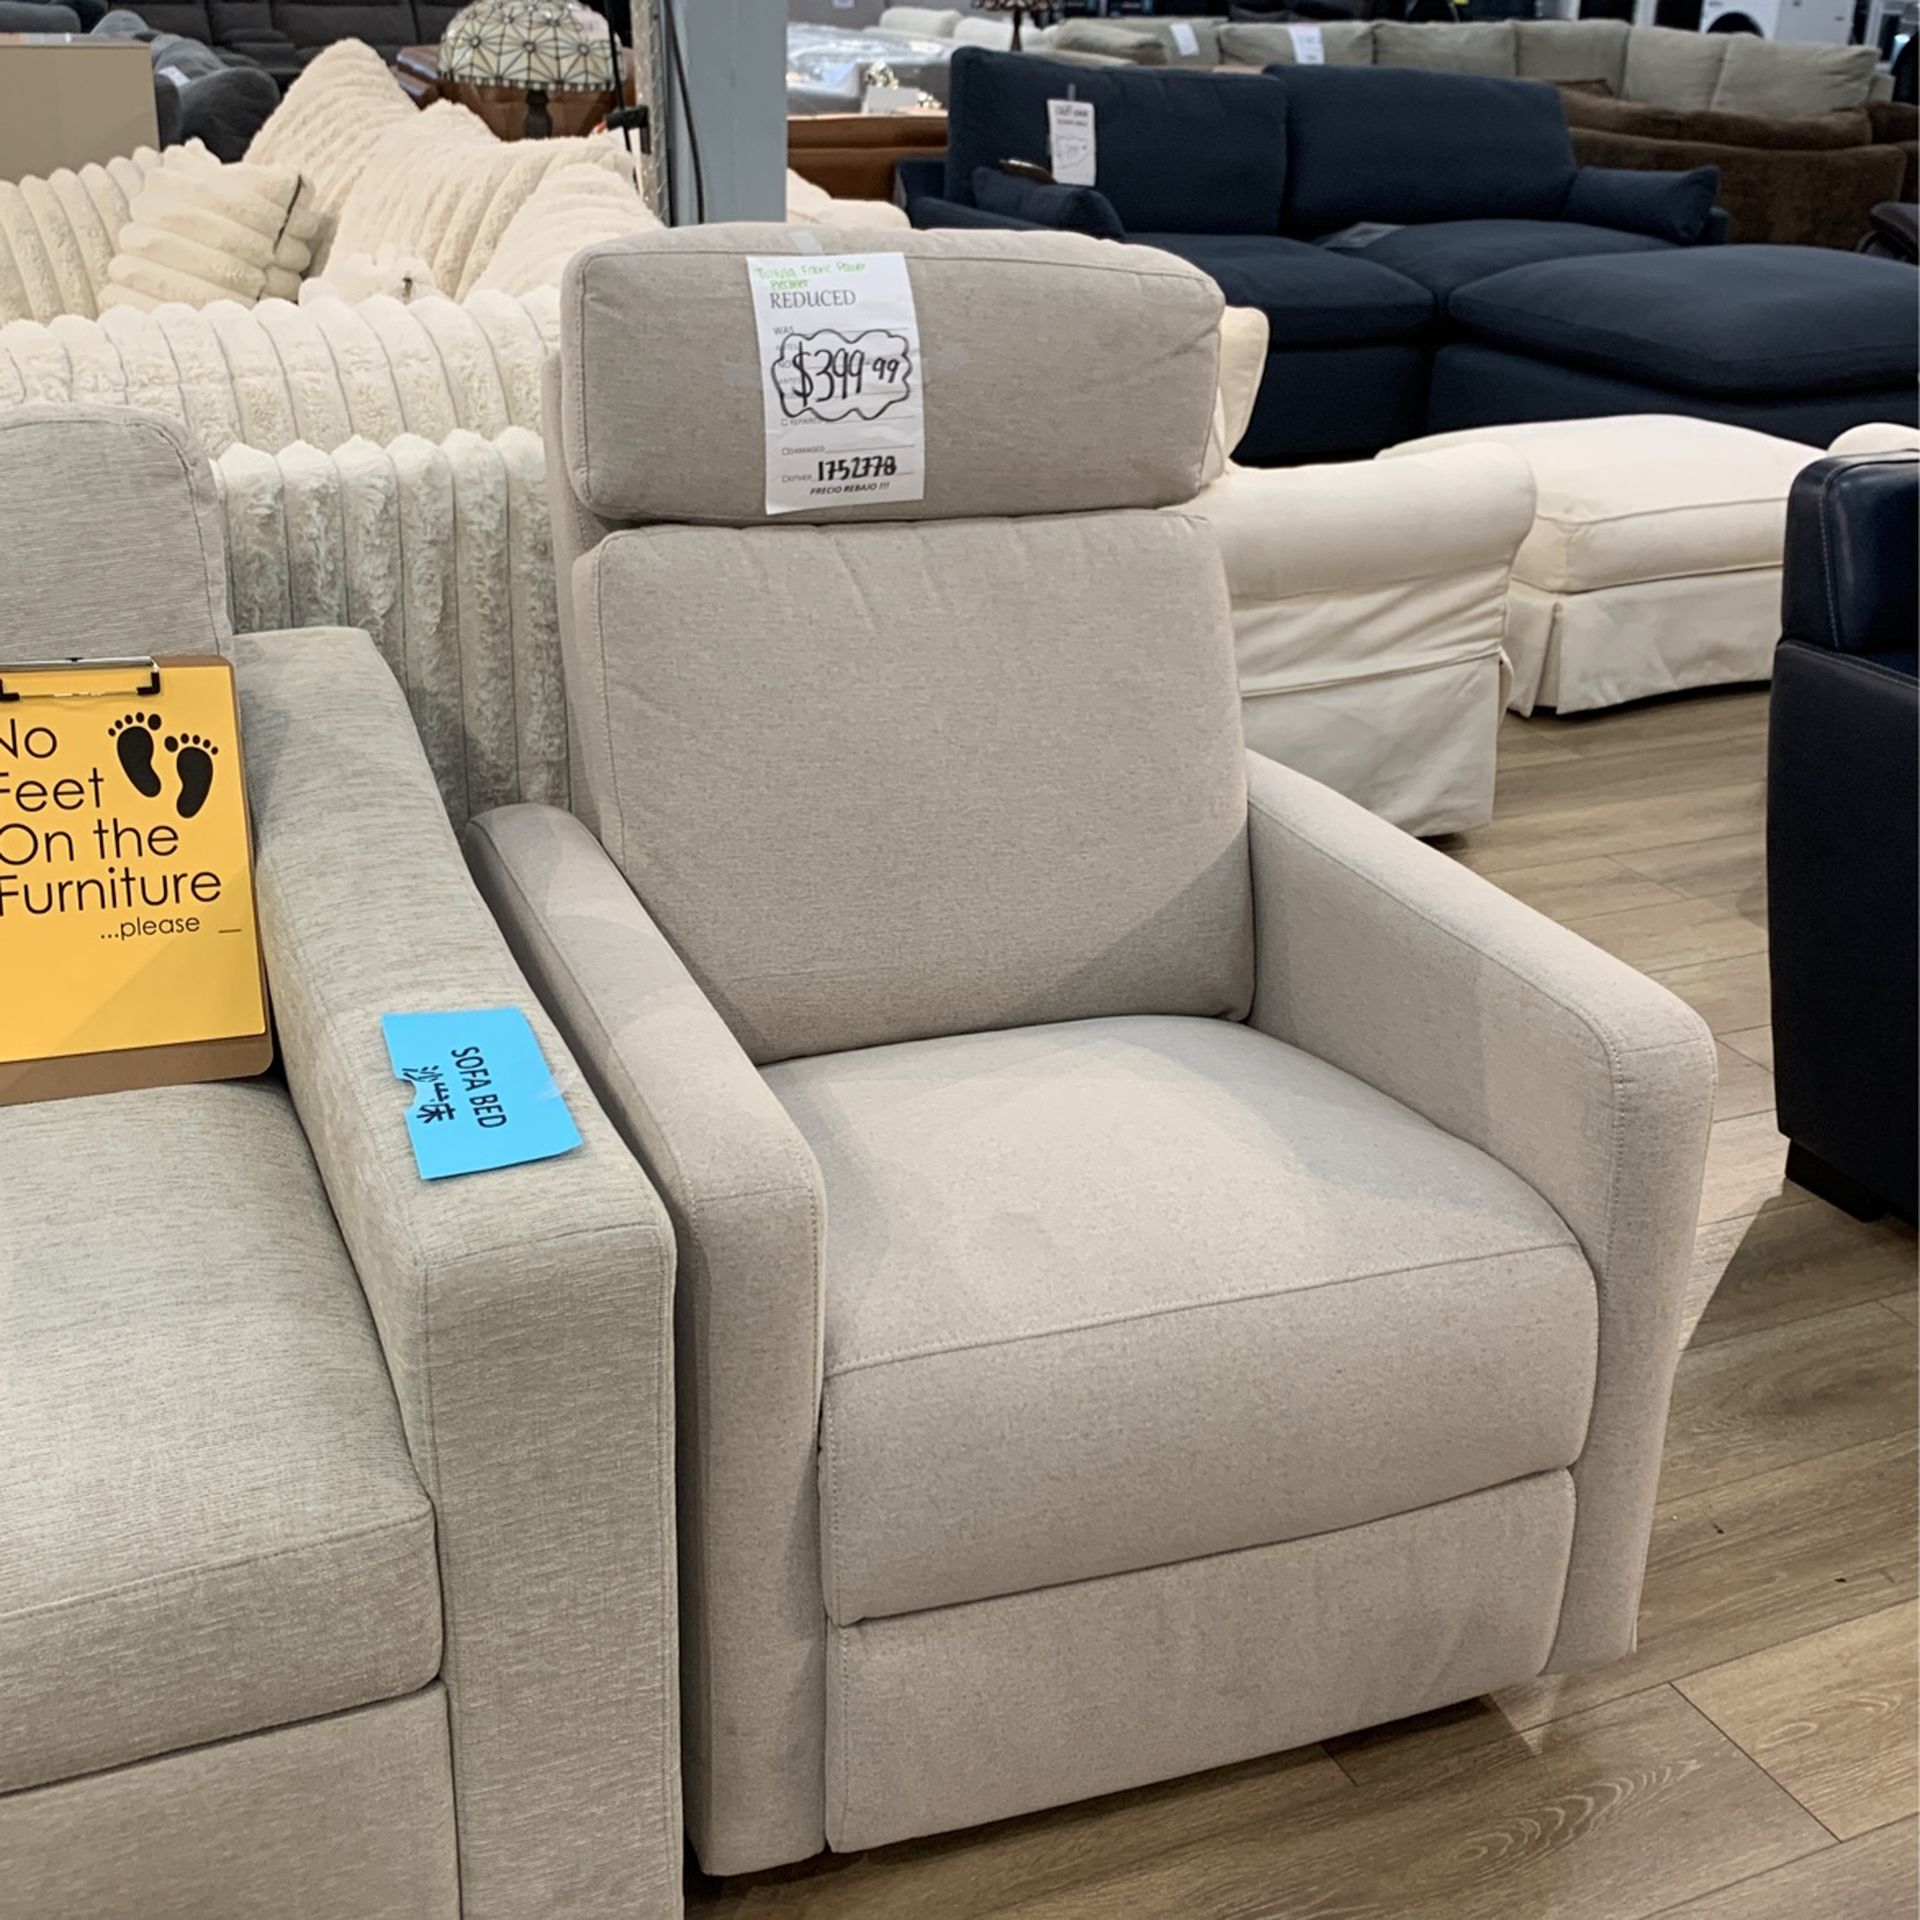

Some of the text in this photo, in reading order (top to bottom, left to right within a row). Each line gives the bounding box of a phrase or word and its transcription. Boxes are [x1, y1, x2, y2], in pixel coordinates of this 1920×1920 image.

[769, 290, 856, 309] REDUCED
[817, 455, 897, 481] 1752778
[809, 485, 843, 496] PRECIO
[843, 482, 878, 494] REBAJO
[0, 817, 179, 866] On the
[0, 866, 222, 917] Furniture
[451, 1046, 508, 1129] SOFA BED
